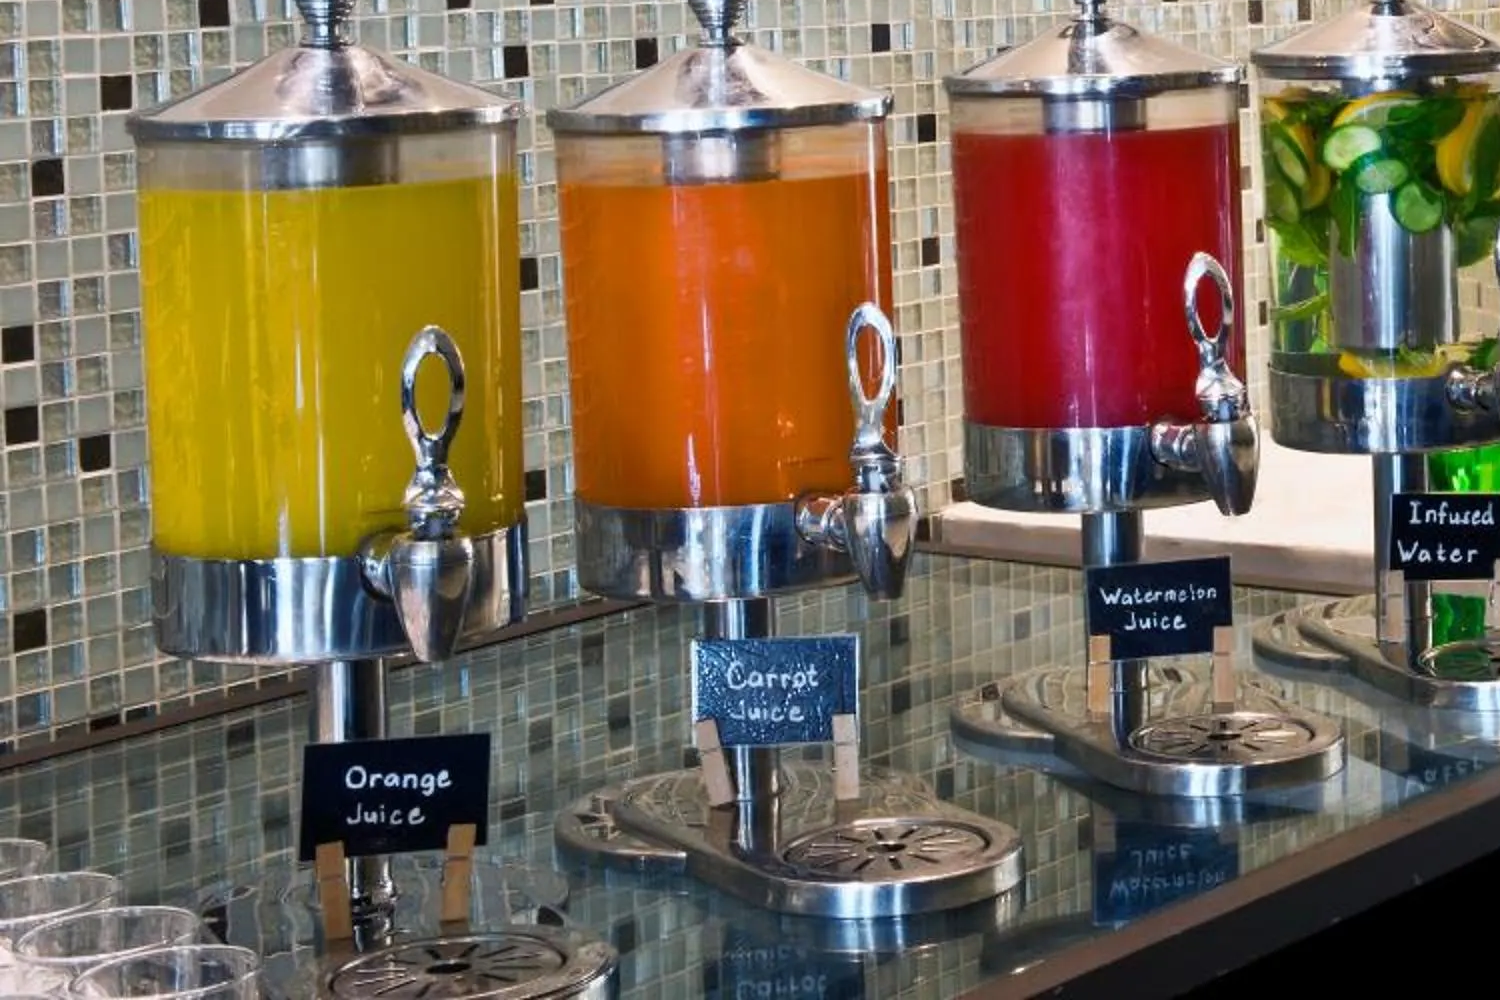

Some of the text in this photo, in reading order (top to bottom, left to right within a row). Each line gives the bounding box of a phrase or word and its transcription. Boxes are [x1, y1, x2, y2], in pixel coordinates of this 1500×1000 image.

[1409, 500, 1495, 526] Infused
[1397, 539, 1479, 563] Water
[1099, 583, 1217, 606] Watermelon
[1124, 611, 1187, 631] Juice
[726, 659, 819, 689] Carrot
[729, 699, 805, 722] Juice
[345, 765, 452, 796] Orange
[346, 802, 426, 825] Juice
